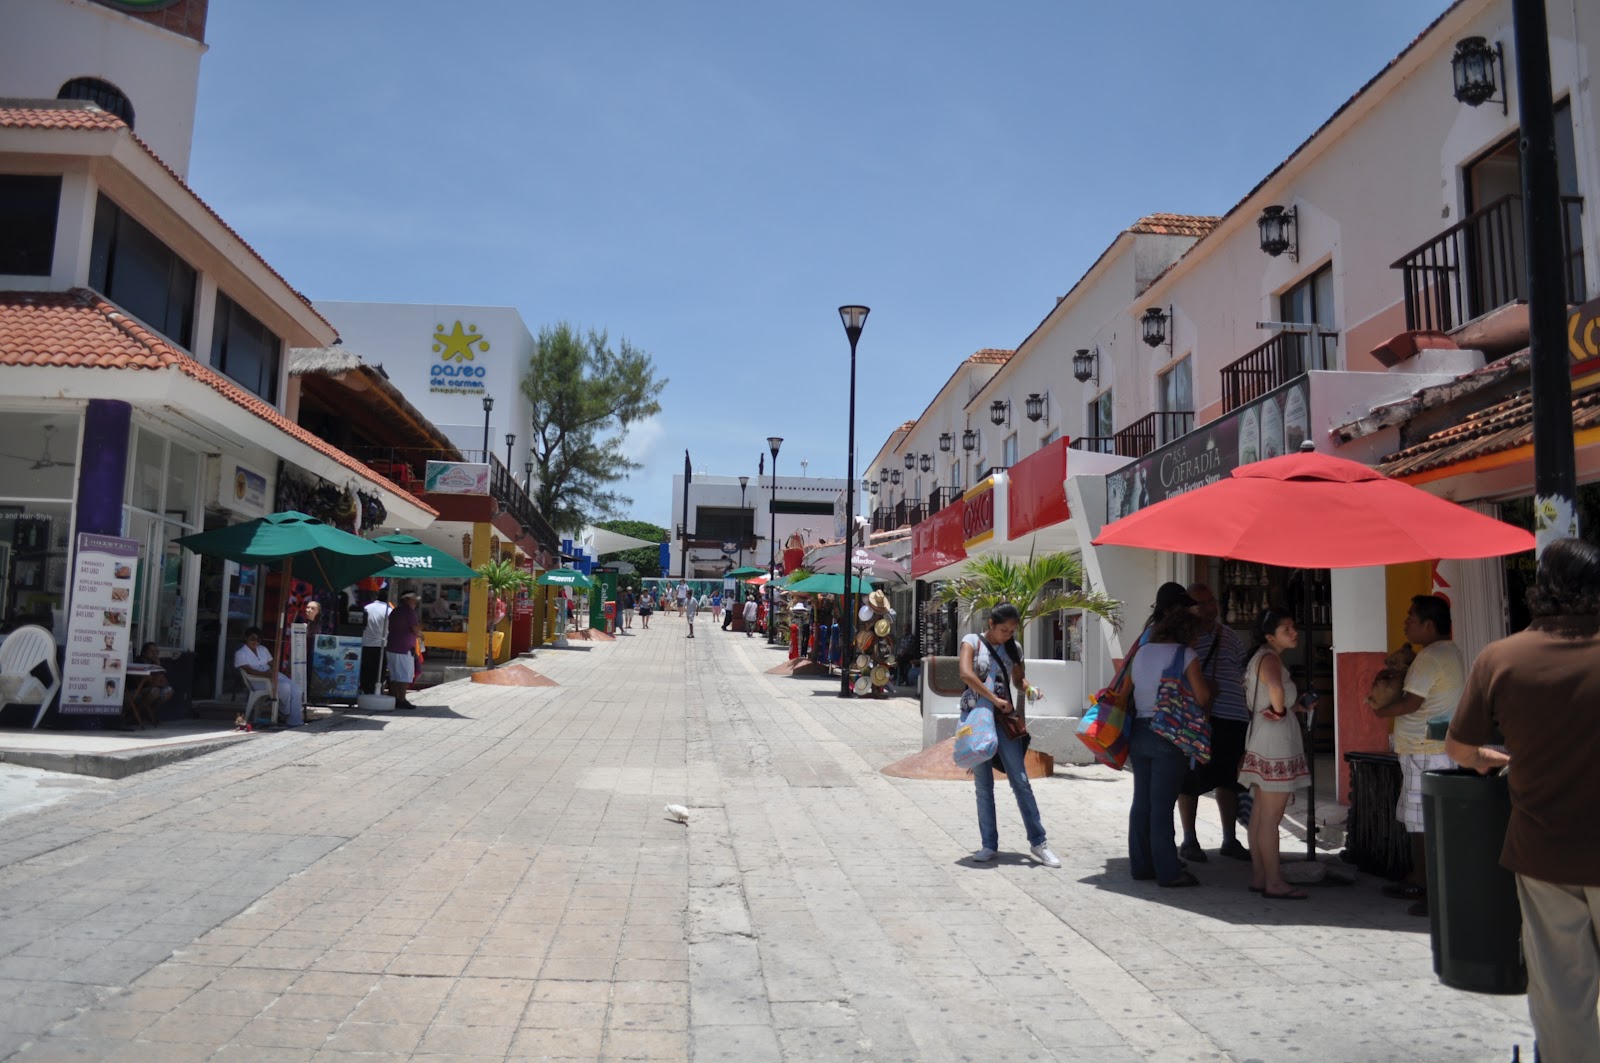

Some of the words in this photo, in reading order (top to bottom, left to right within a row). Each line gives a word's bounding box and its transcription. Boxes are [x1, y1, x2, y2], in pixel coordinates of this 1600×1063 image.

[431, 365, 486, 378] paseo
[430, 378, 446, 386] del
[448, 379, 485, 388] carmen
[1205, 474, 1220, 486] Store
[964, 493, 989, 538] OXXO
